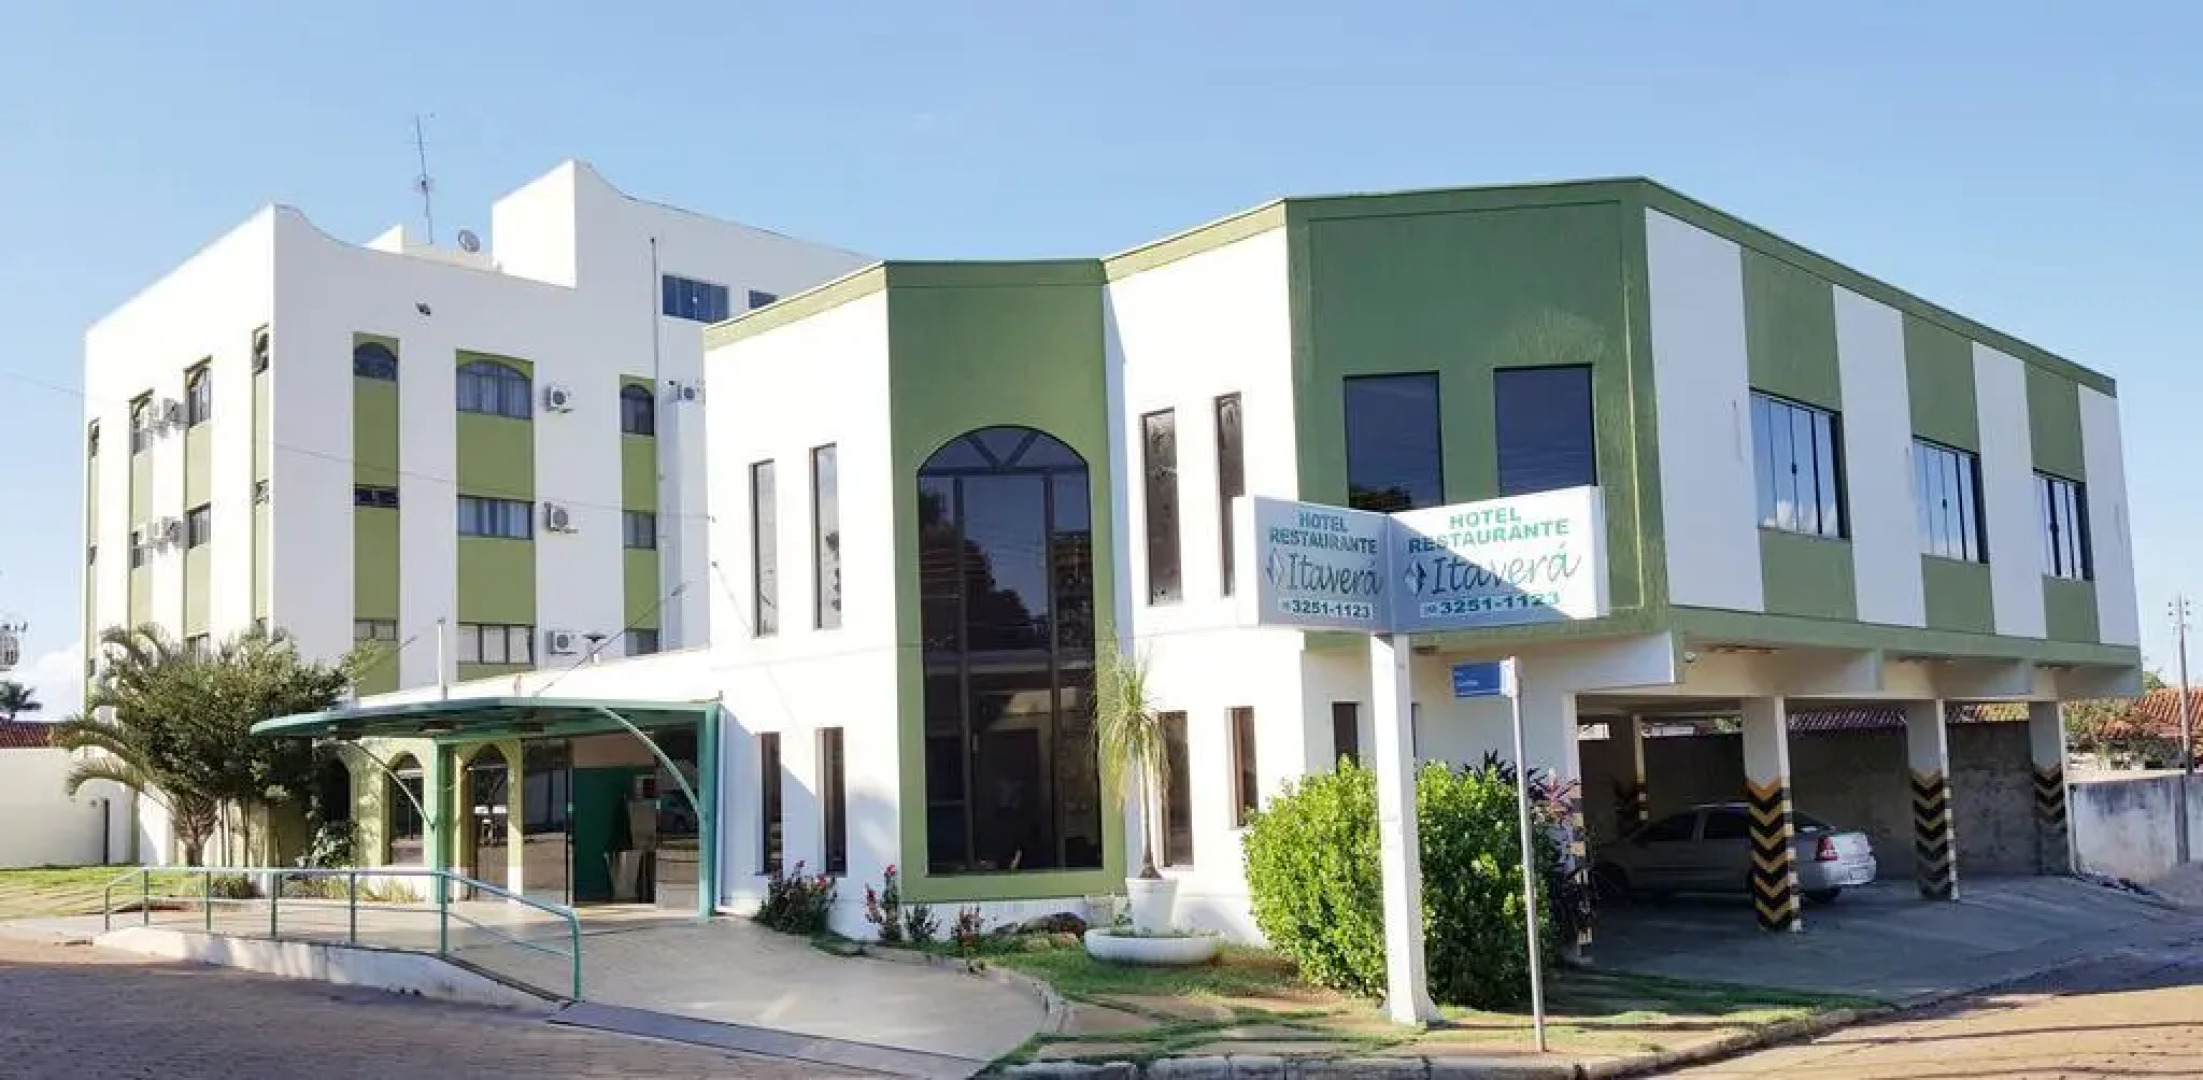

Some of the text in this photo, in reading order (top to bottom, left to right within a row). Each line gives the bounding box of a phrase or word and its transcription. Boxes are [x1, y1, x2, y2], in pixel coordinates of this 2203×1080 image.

[1299, 512, 1348, 532] HOTEL
[1450, 507, 1522, 529] HOTEL
[1269, 527, 1378, 553] RESTAURANTE
[1409, 518, 1569, 553] RESTAURANTE
[1288, 553, 1384, 594] Itaverá
[1431, 542, 1581, 594] Itaverá
[1292, 599, 1370, 618] 3251-1123
[1440, 592, 1560, 614] 3251-1123
